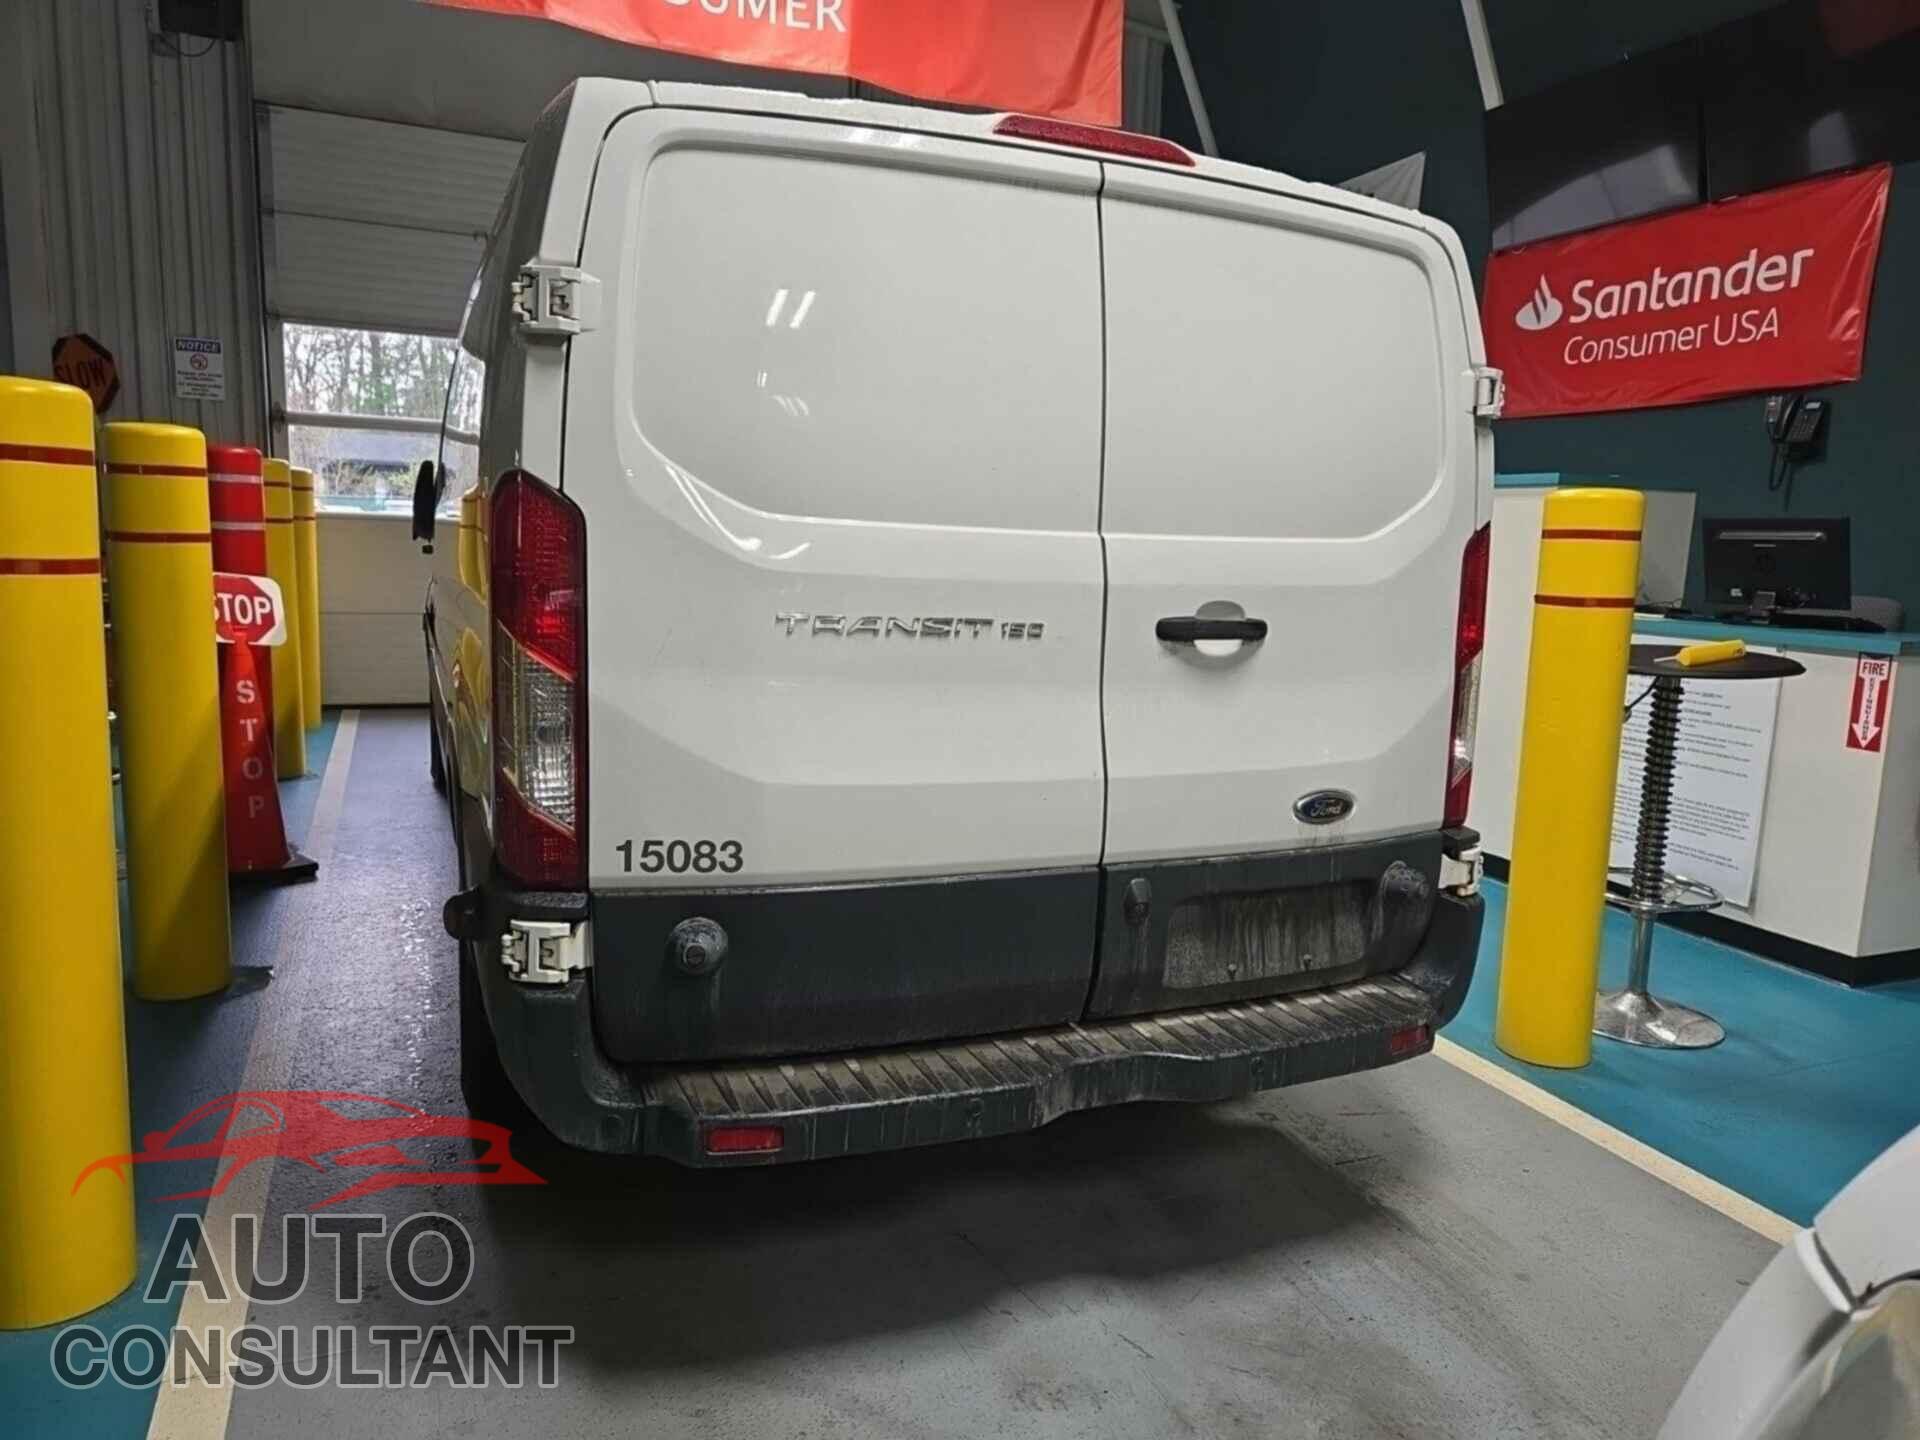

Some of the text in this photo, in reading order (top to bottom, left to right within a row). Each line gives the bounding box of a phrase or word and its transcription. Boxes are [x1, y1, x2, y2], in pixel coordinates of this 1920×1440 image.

[1569, 248, 1815, 323] Santander
[1564, 307, 1779, 365] Consumer USA
[214, 592, 272, 625] TOP
[775, 612, 1045, 639] TRANSIT 150
[1862, 661, 1887, 676] FIRE
[236, 679, 264, 819] STOP
[616, 839, 743, 873] 15083
